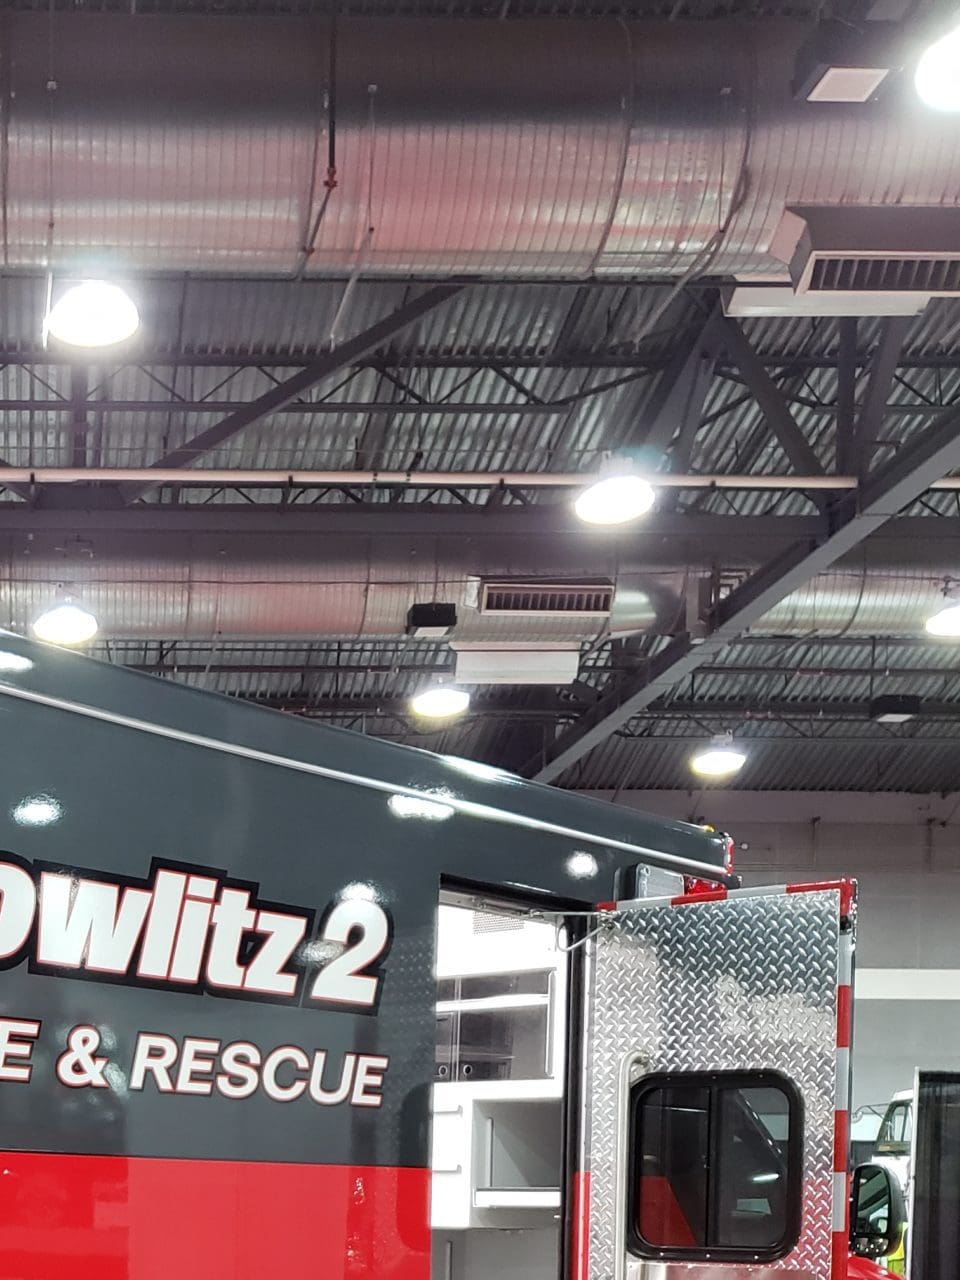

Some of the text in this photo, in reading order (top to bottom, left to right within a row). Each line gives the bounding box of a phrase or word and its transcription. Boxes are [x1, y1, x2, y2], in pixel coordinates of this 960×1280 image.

[308, 896, 390, 1006] 2
[55, 1023, 111, 1089] &
[128, 1030, 389, 1108] RESCUE
